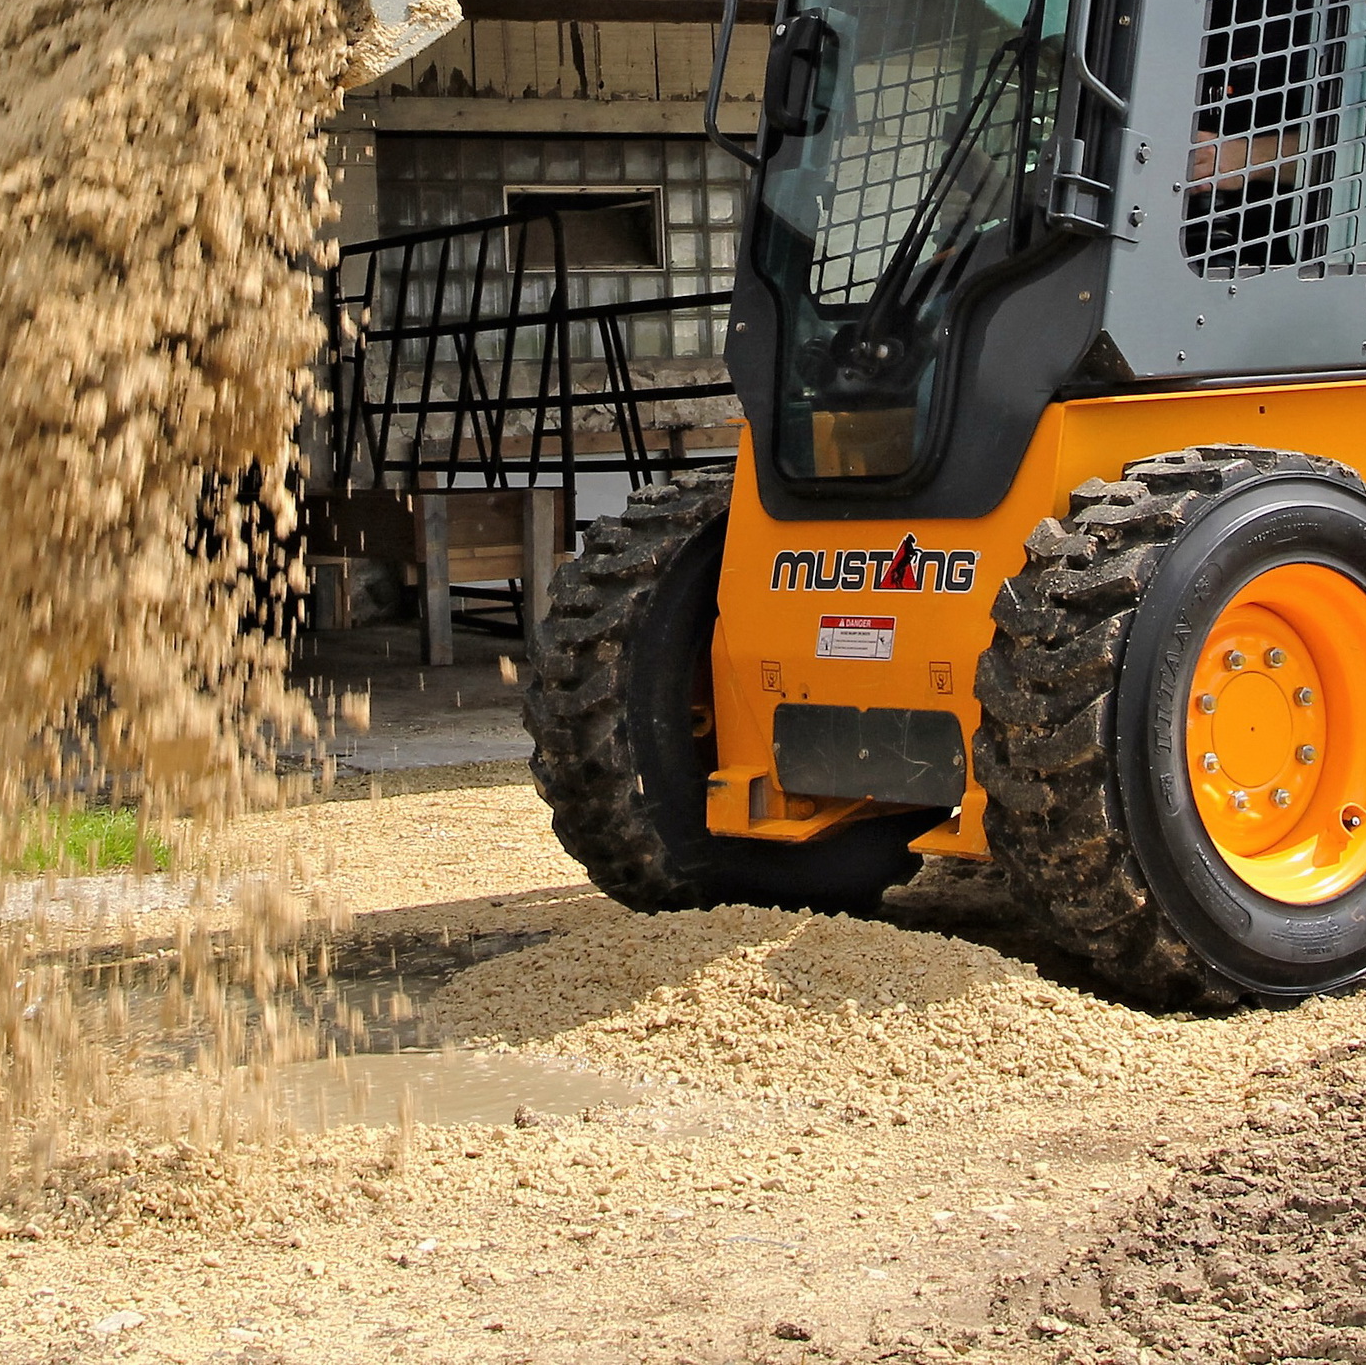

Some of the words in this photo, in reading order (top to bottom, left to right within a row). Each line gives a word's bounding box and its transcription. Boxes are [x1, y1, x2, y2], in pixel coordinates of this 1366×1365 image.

[769, 533, 977, 593] MUSTANG
[845, 619, 872, 628] DANGER
[1153, 608, 1193, 756] TITAN
